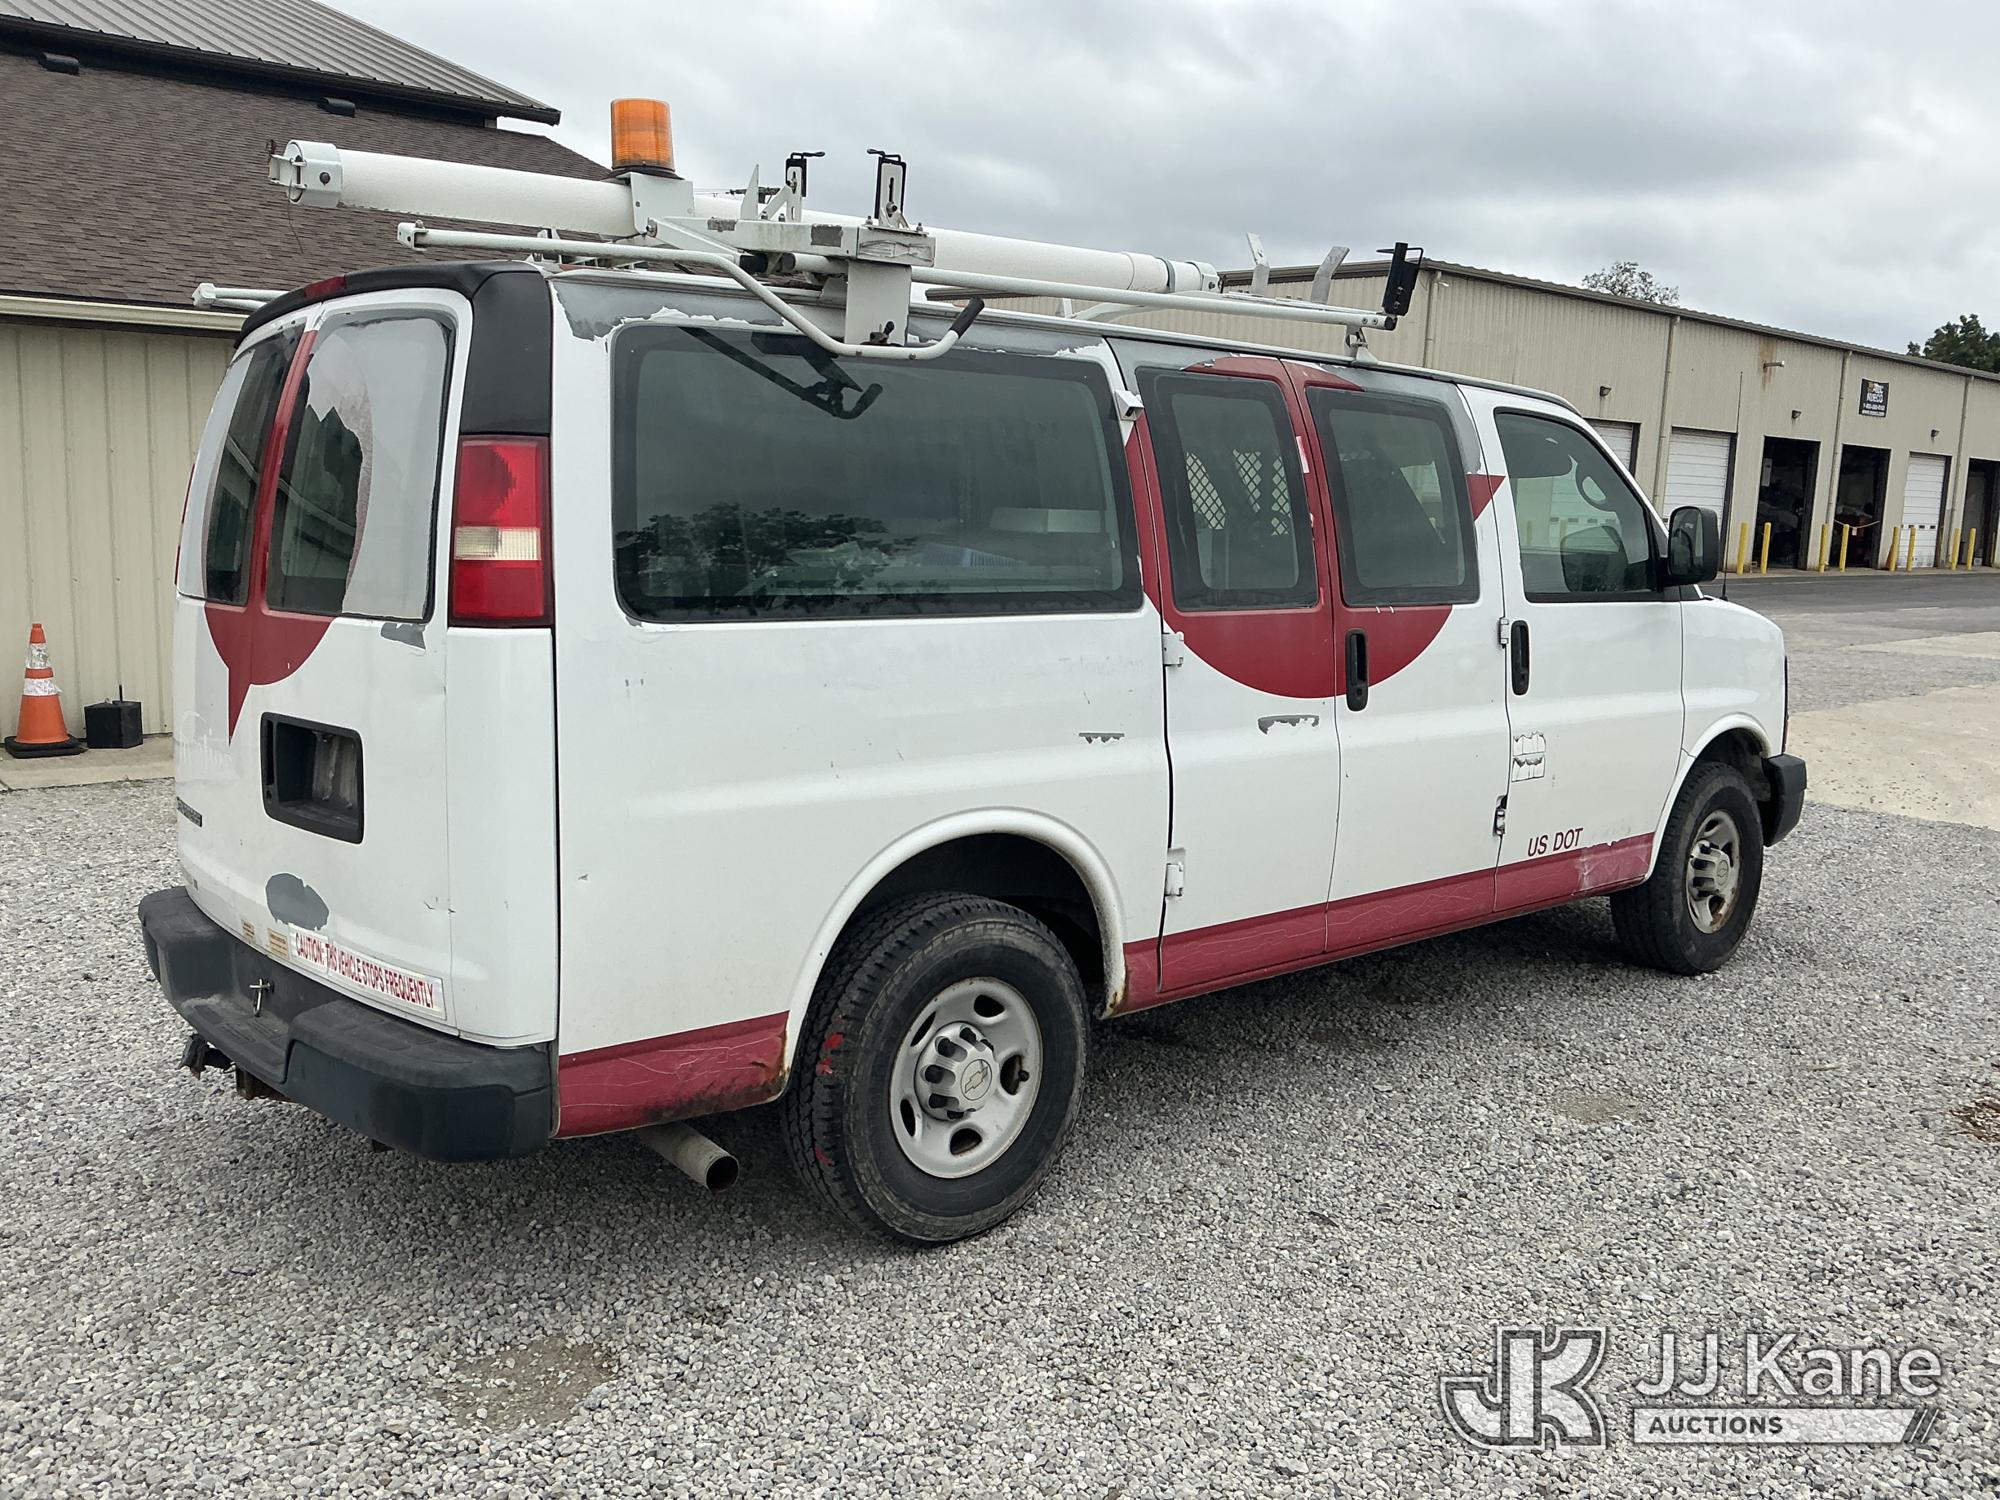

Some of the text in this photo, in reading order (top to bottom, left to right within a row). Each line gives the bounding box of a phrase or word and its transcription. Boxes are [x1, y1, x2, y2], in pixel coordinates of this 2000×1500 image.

[1528, 828, 1583, 857] US DOT
[295, 932, 325, 966] CAUTION:
[325, 943, 339, 972] THIS
[338, 949, 362, 983] VEHICLE
[362, 960, 384, 993] STOPS
[384, 969, 434, 1009] FREQUENTLY
